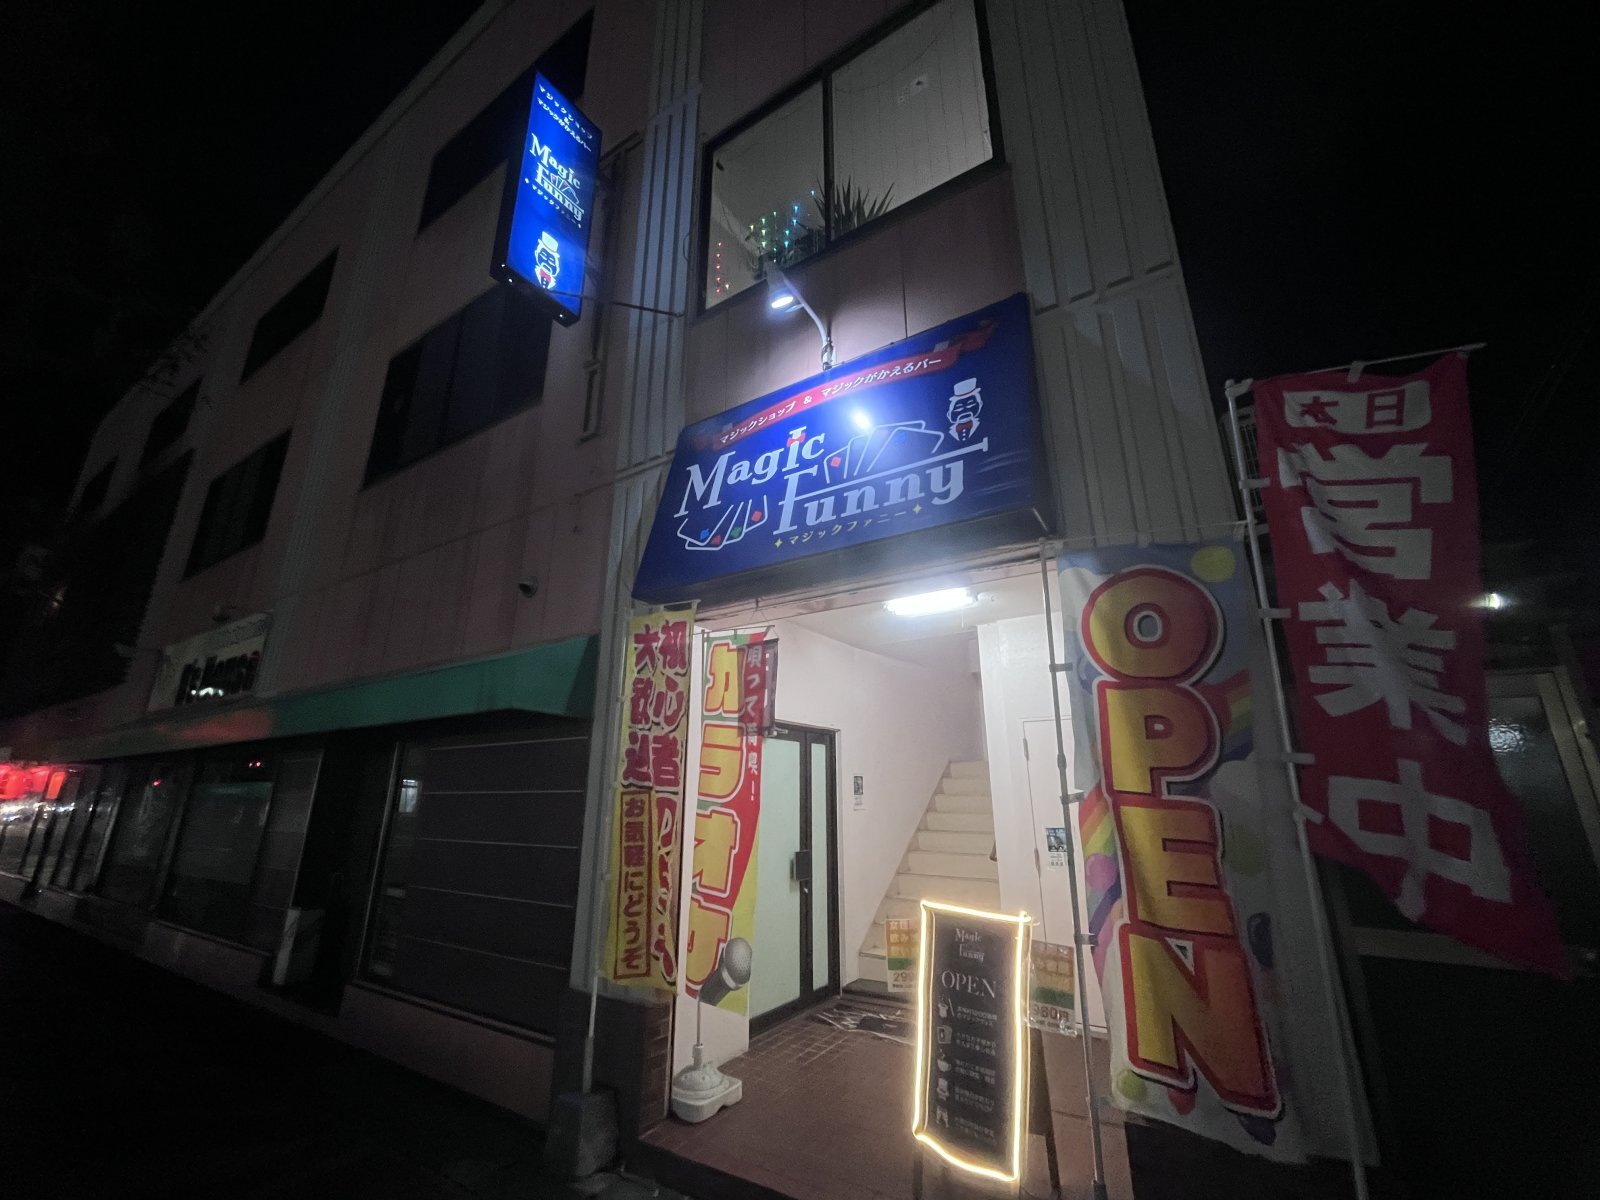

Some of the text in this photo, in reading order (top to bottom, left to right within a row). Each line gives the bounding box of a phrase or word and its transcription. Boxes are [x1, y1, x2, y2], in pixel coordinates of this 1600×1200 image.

[529, 132, 581, 190] Magic
[535, 162, 585, 222] Funny
[720, 357, 942, 444] マジックショップ & マジックがかえるバー
[673, 426, 826, 519] Magic
[773, 450, 976, 535] Funny
[789, 511, 907, 544] マジックファニー
[1278, 443, 1512, 923] 営業中
[1083, 566, 1282, 1120] OPEN
[941, 970, 996, 999] OPEN
